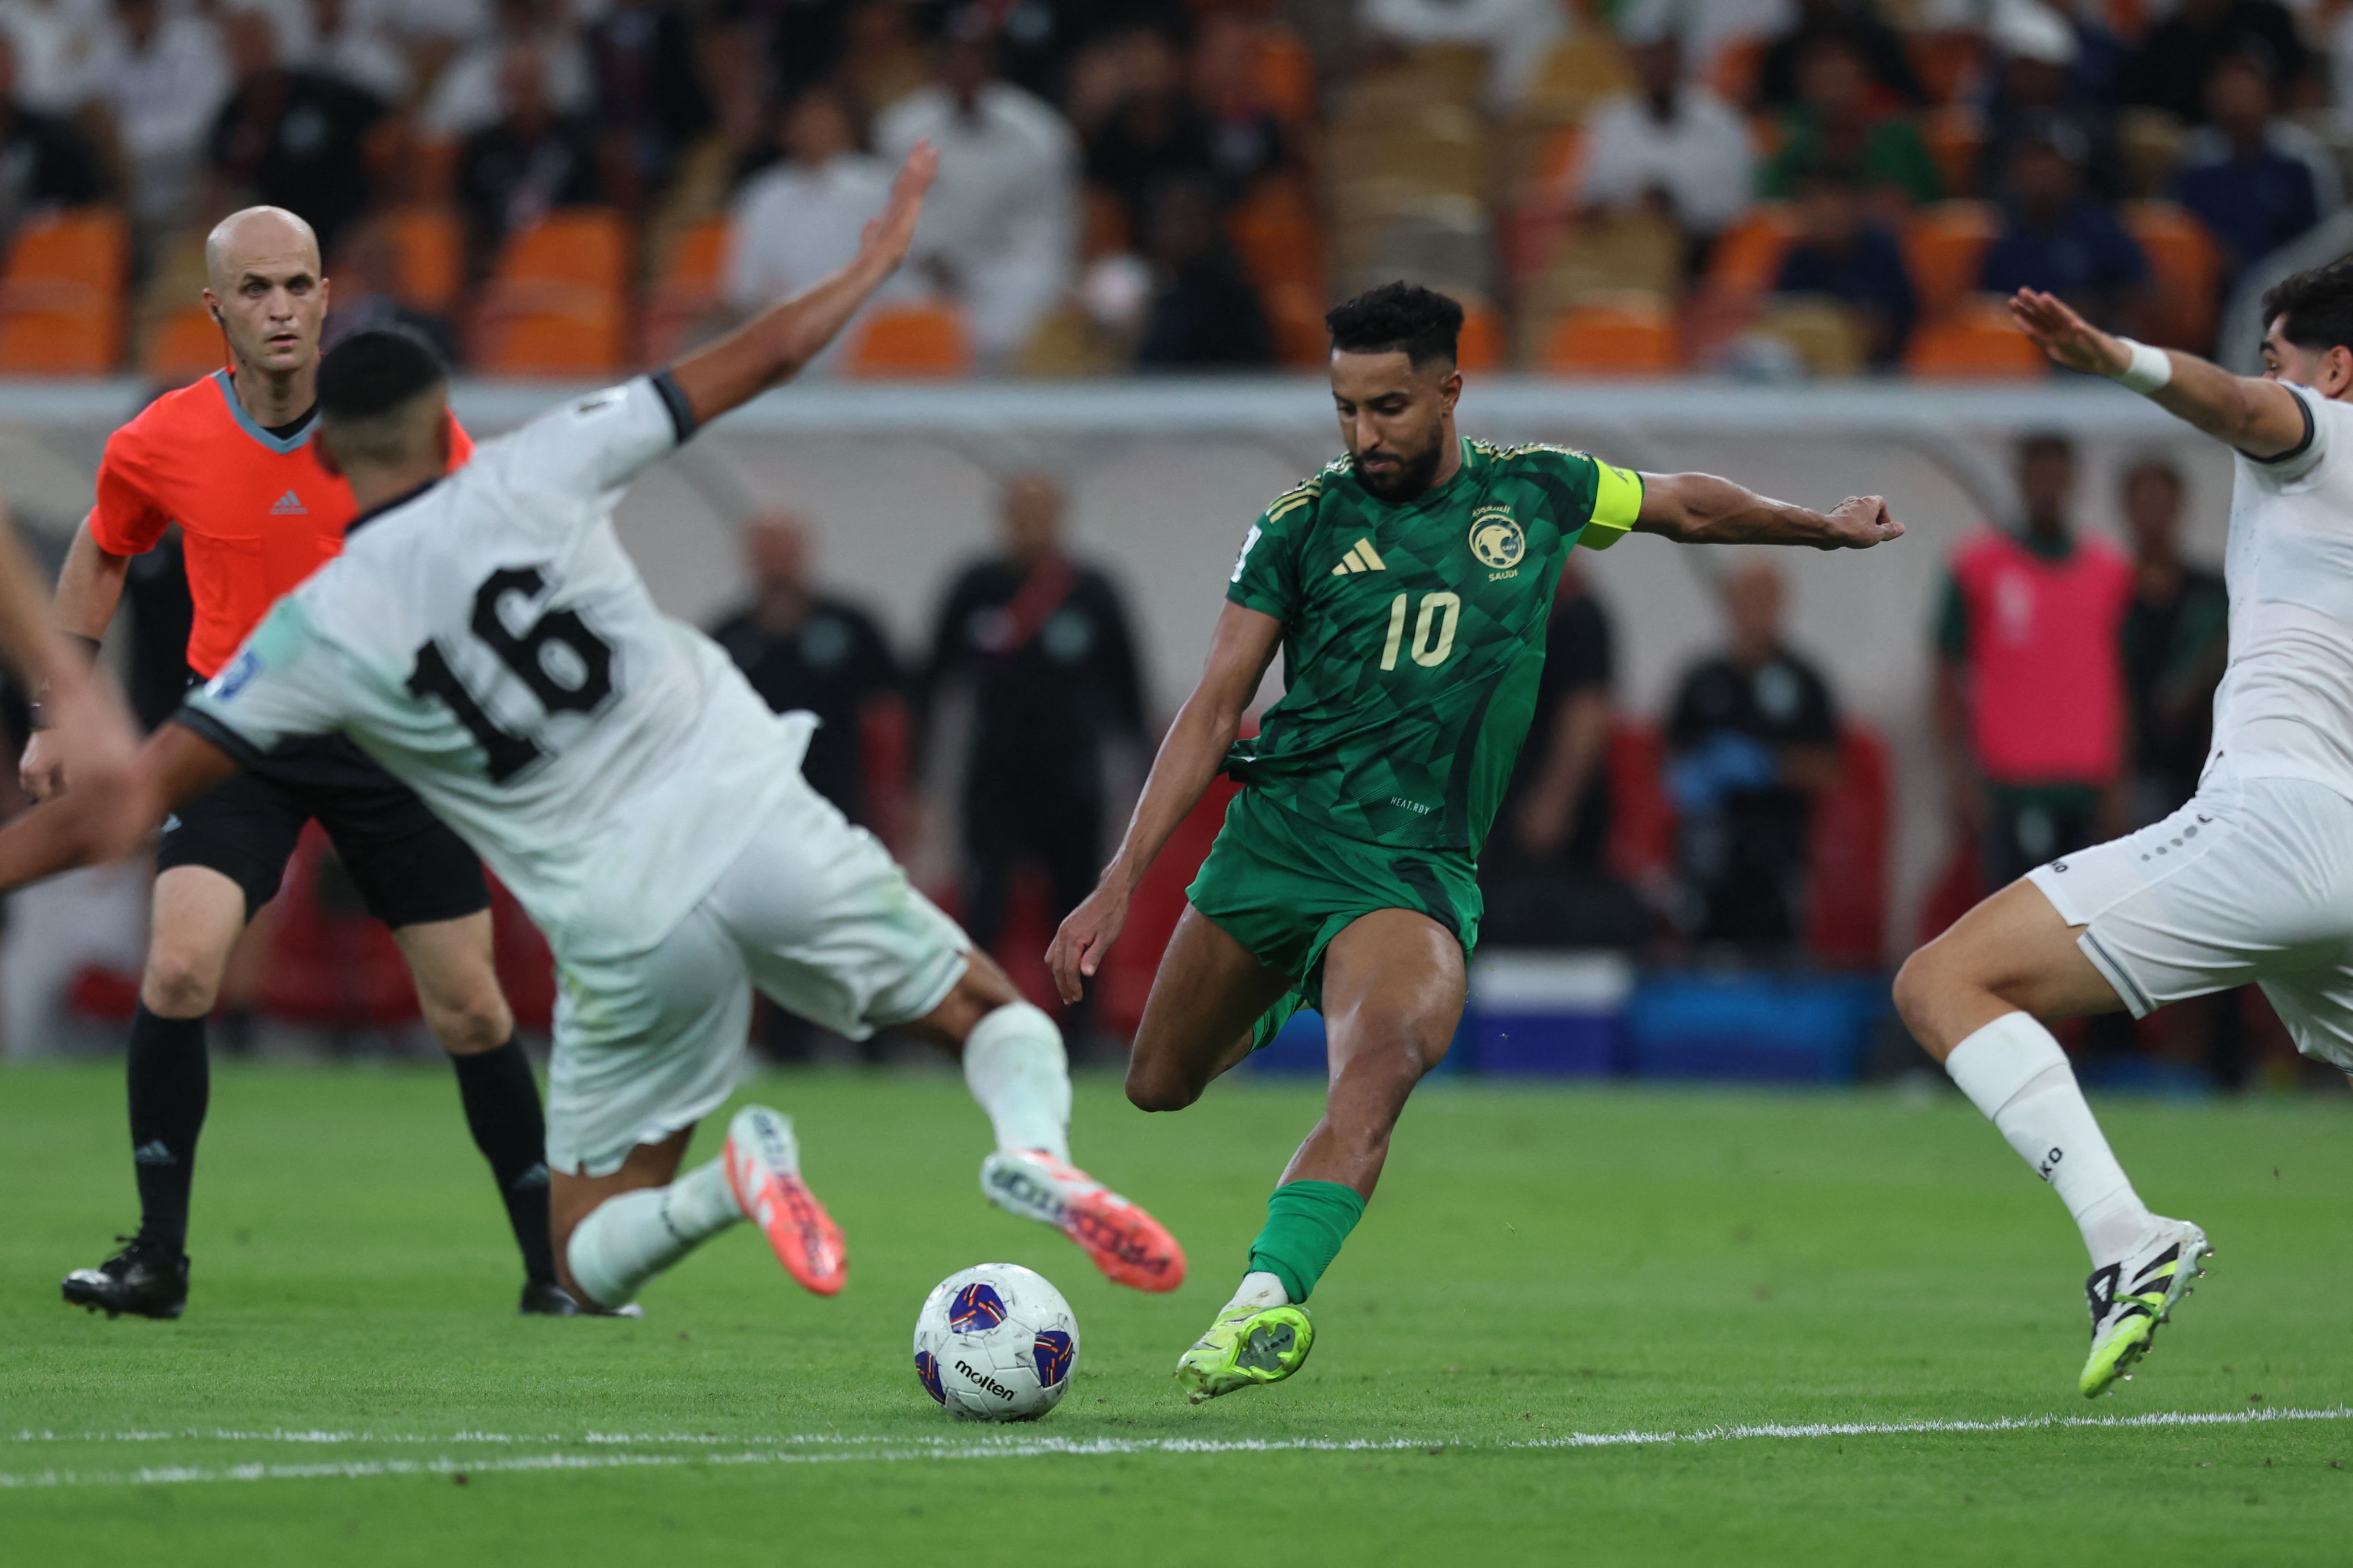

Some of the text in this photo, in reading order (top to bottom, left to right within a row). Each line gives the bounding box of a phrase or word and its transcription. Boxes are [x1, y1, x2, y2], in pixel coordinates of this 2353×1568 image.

[1488, 569, 1518, 582] SAUDI
[1379, 591, 1461, 671] 10
[406, 564, 626, 786] 16
[1390, 796, 1430, 815] HEAT.RDY
[954, 1360, 1015, 1401] molten
